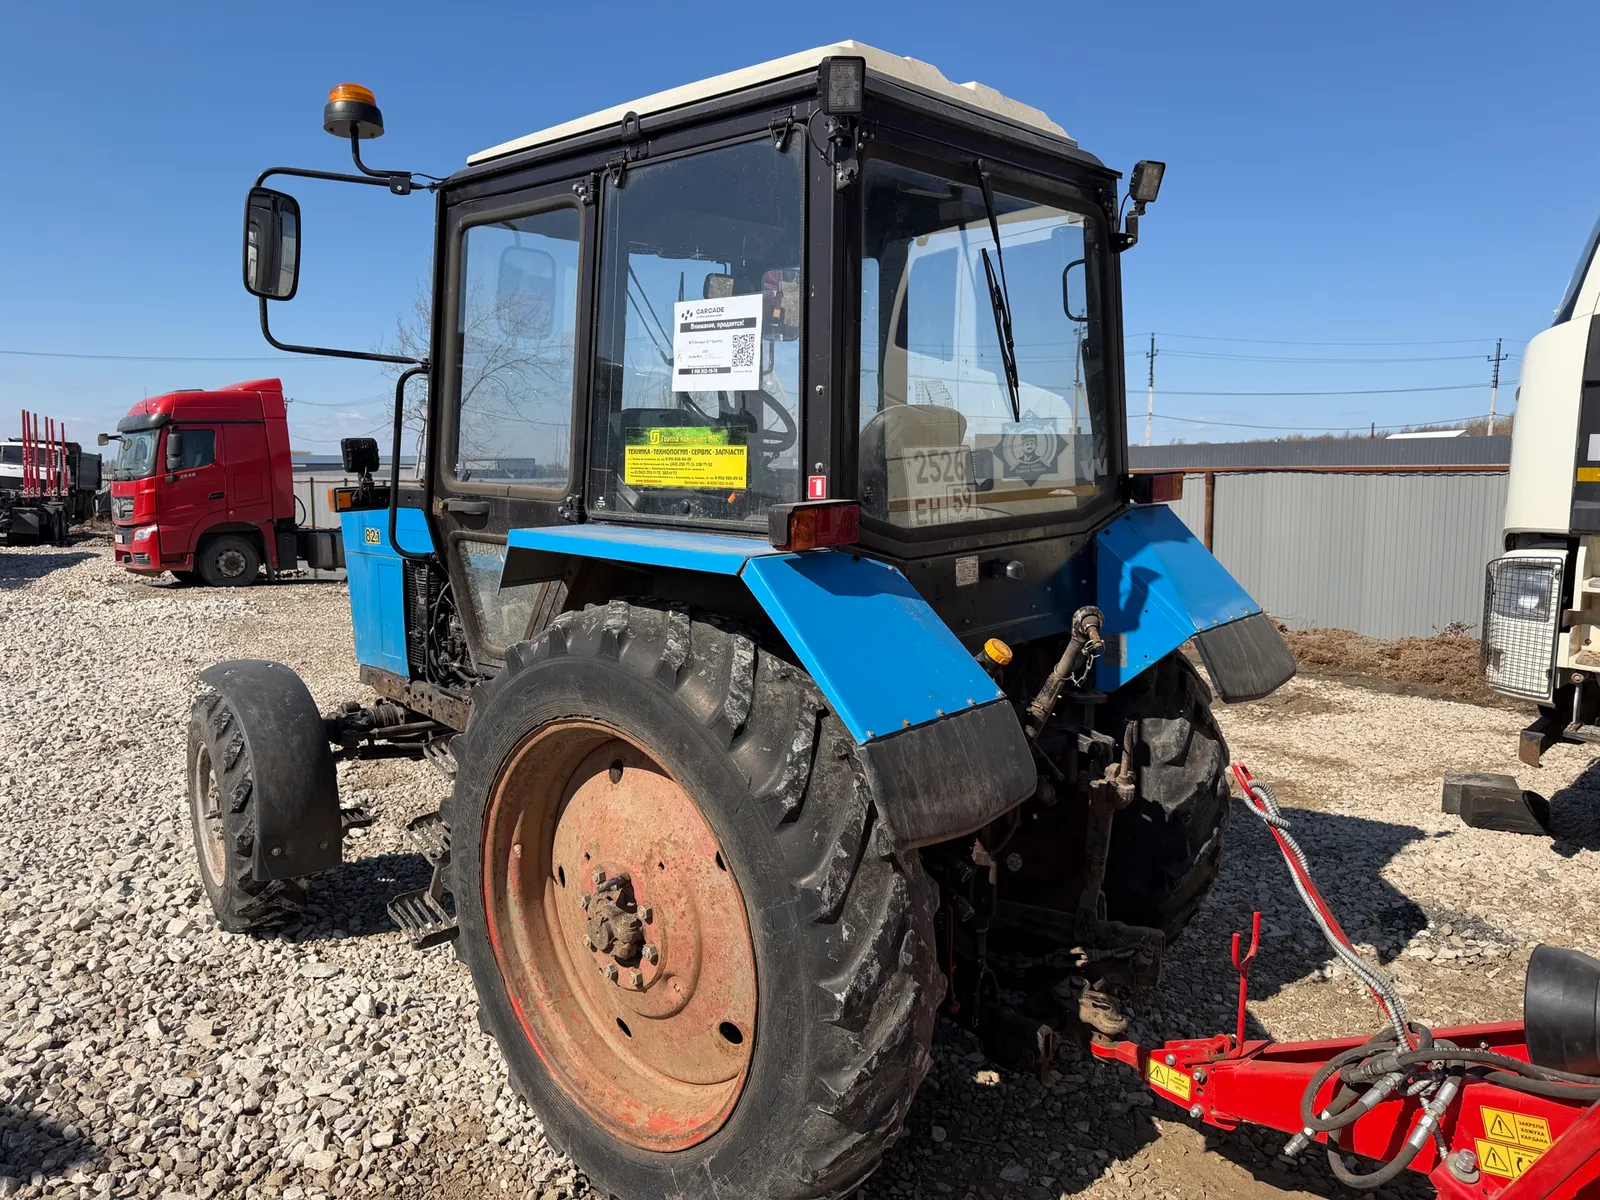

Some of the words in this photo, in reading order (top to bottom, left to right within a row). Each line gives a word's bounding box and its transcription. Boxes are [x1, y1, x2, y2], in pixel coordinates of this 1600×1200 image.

[690, 322, 716, 330] Внимание,
[716, 319, 745, 328] продается!
[662, 435, 680, 443] Группа
[691, 448, 712, 456] СЕРВИС
[714, 448, 745, 456] ЗАПЧАСТИ
[1518, 1120, 1545, 1130] ЗАКРЕПИ
[1520, 1127, 1545, 1137] КОЖУХА
[1520, 1134, 1548, 1144] КАРДАНА
